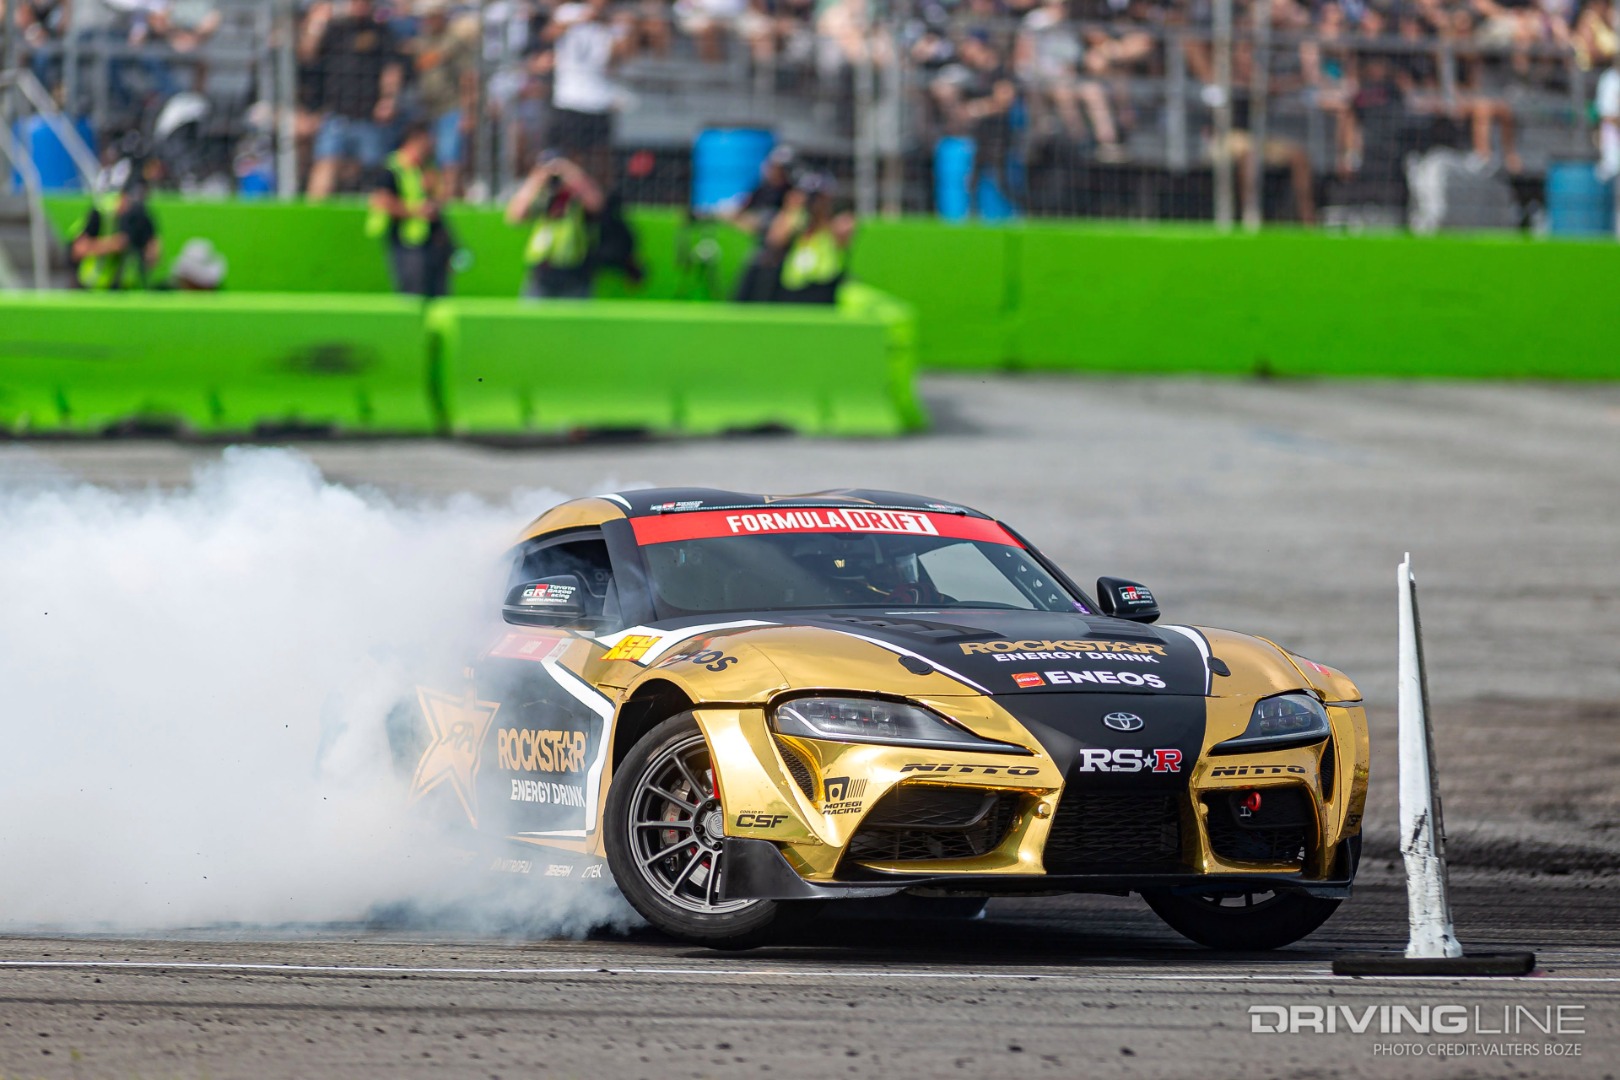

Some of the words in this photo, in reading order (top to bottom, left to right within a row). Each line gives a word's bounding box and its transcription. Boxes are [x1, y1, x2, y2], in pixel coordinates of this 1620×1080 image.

[726, 509, 846, 533] FORMULA
[849, 511, 929, 532] DRIFT
[522, 588, 547, 597] GR
[1121, 591, 1138, 600] GR
[959, 639, 1168, 656] ROCKSTAR
[992, 651, 1082, 662] ENERGY
[1088, 652, 1161, 664] DRINK
[1044, 670, 1167, 689] ENEOS
[498, 728, 586, 773] ROCKSTAR
[900, 763, 1040, 776] NITTO
[1211, 765, 1306, 777] NITTO
[510, 779, 550, 804] ENERGY
[552, 783, 586, 808] DRINK
[822, 807, 861, 815] RACING
[824, 801, 862, 810] MOTEGI
[736, 814, 788, 828] CSF
